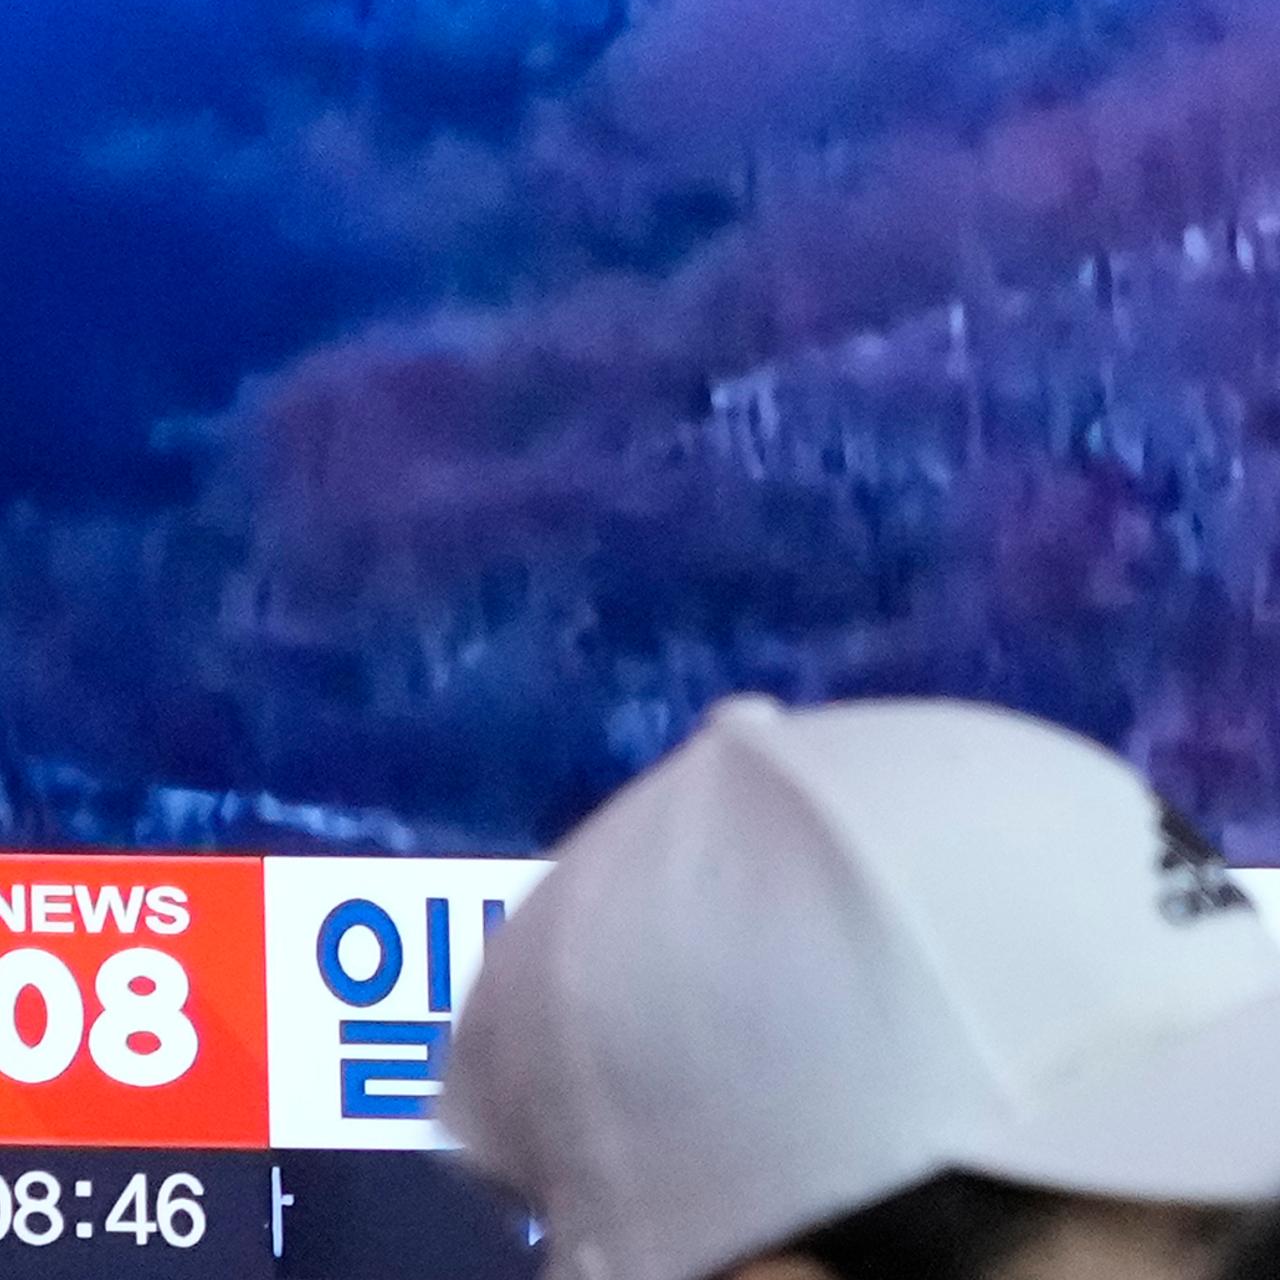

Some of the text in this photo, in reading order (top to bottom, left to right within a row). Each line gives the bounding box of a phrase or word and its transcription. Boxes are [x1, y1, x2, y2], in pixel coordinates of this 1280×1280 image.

[0, 947, 199, 1088] 08
[316, 897, 507, 1120] 일
[0, 1170, 207, 1248] 8:46
